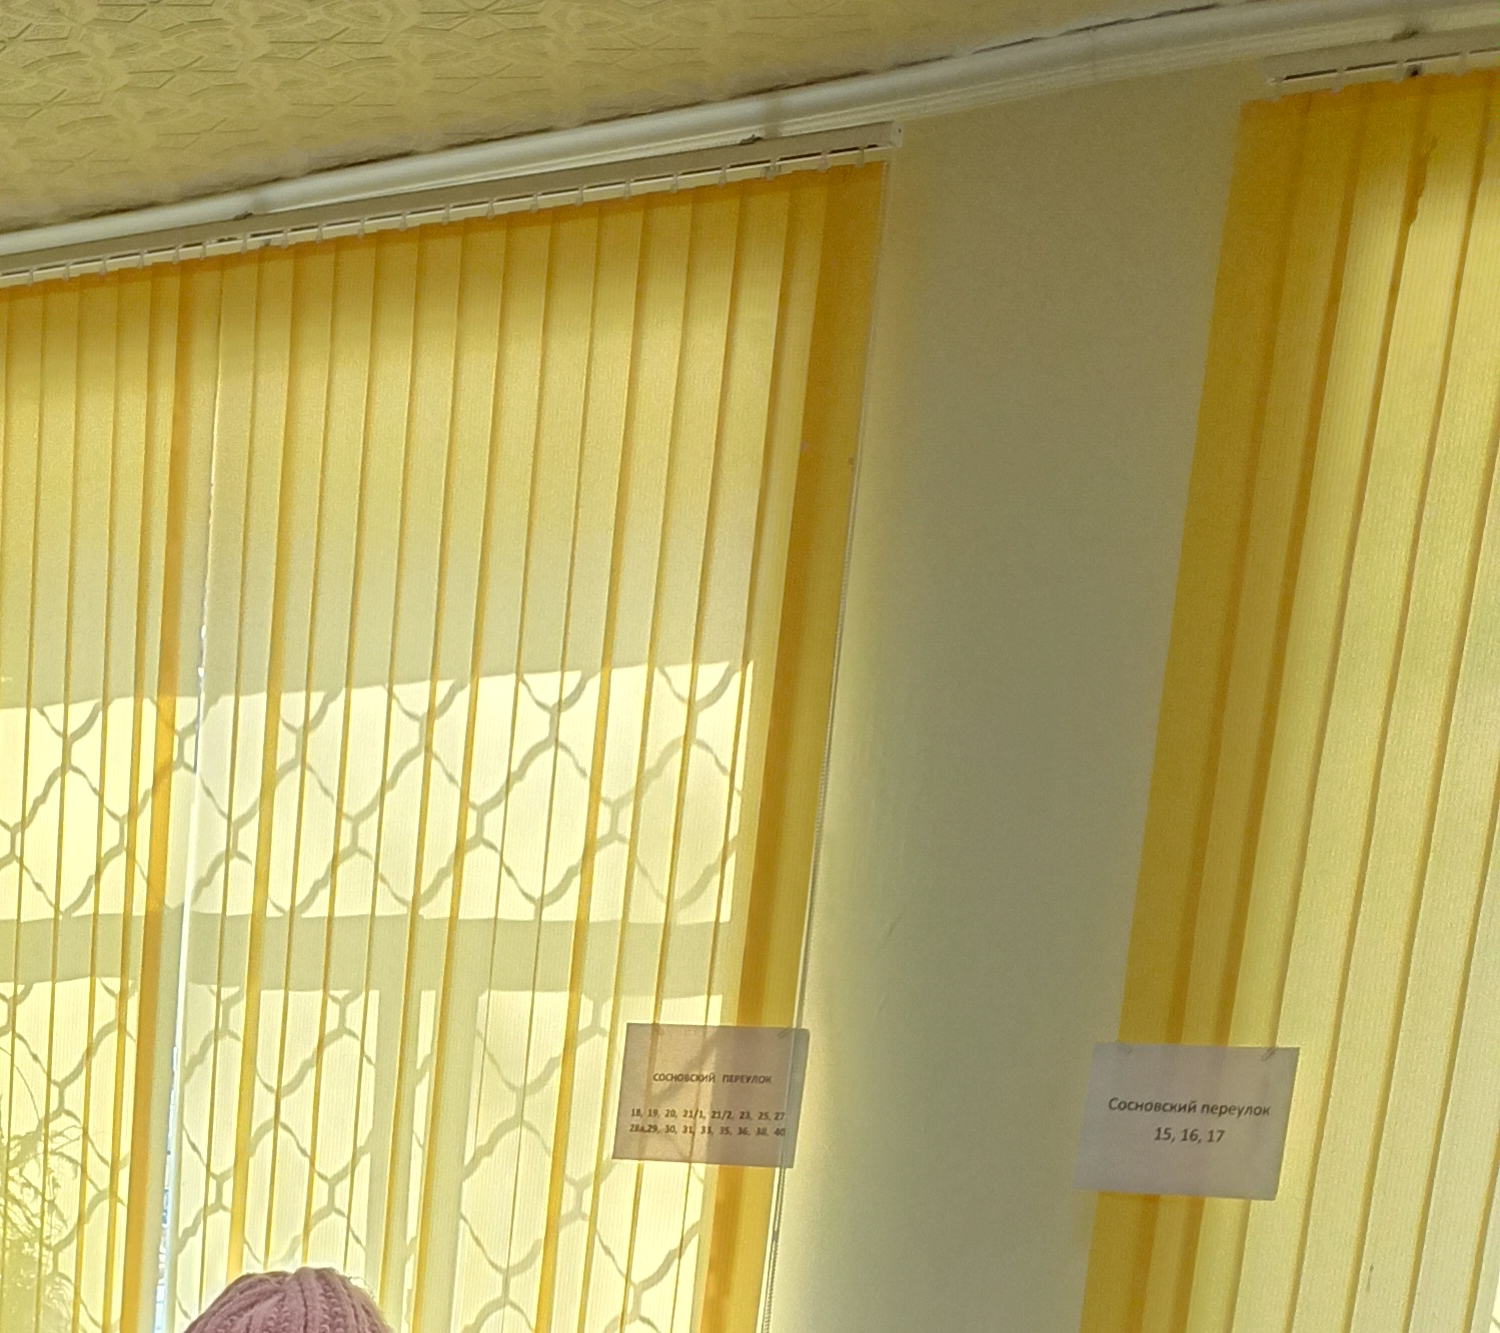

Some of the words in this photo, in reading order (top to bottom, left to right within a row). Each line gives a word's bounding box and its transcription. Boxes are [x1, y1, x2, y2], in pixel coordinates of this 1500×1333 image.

[652, 1072, 716, 1083] СОСНОВСКИЙ
[722, 1074, 772, 1084] ПЕРЕУЛОК
[1108, 1096, 1197, 1114] Сосновский
[1201, 1102, 1271, 1119] переулок
[1154, 1127, 1176, 1143] 15,
[1180, 1127, 1202, 1144] 16,
[1207, 1129, 1225, 1143] 17
